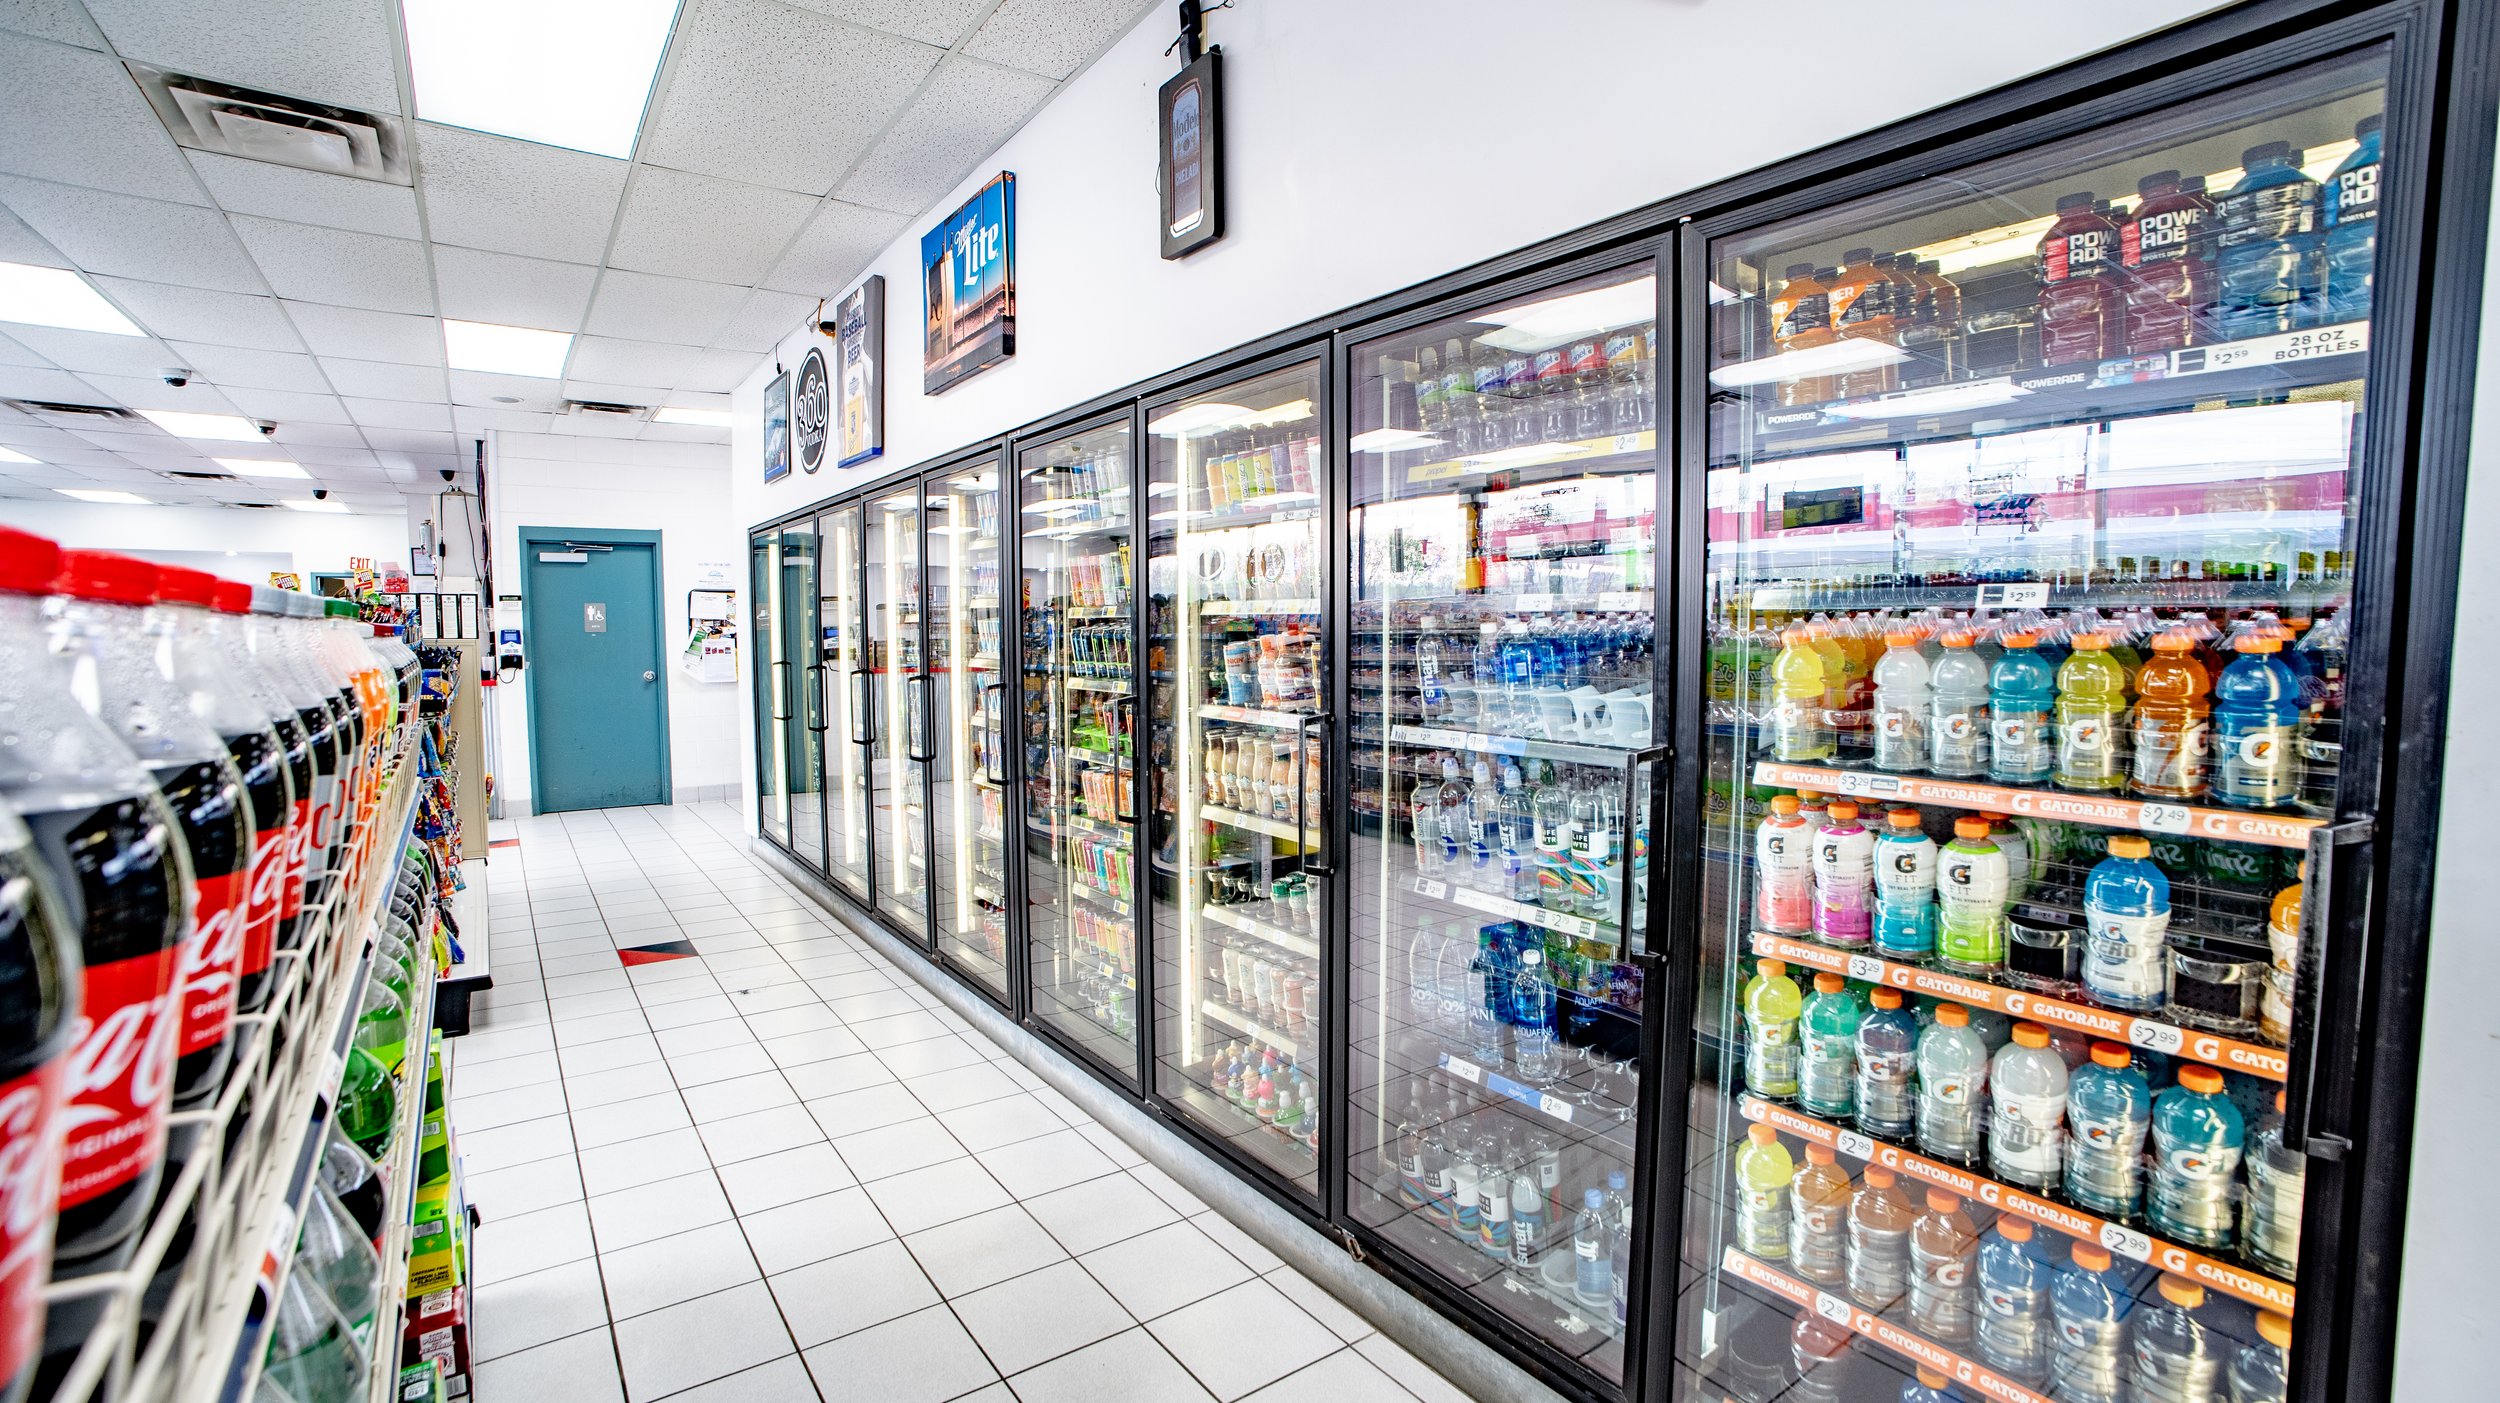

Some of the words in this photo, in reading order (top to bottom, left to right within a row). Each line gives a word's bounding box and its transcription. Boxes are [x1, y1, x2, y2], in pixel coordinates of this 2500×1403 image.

[2339, 164, 2381, 191] PO
[2338, 183, 2380, 209] AD
[2141, 226, 2188, 250] ADE
[963, 222, 999, 286] Lite
[2069, 246, 2108, 265] ADE
[2141, 252, 2167, 263] SPORTS
[2274, 339, 2360, 361] BOTTLES
[2290, 334, 2312, 347] 28
[2318, 329, 2345, 344] OZ
[2021, 372, 2086, 390] POWERADE
[797, 373, 826, 449] 360
[1767, 410, 1817, 426] POWERADE
[806, 428, 823, 449] VODKA
[350, 556, 371, 570] EXIT
[1420, 654, 1435, 698] smart
[1944, 713, 1969, 739] G
[2000, 719, 2025, 746] G
[2069, 718, 2102, 751] G
[2239, 732, 2280, 768] G
[1761, 765, 1777, 783] G
[1782, 770, 1838, 788] GATORAD
[1898, 780, 1913, 799] G
[1920, 785, 1998, 805] GATORADE
[2011, 793, 2032, 813] G
[2039, 799, 2128, 820] GATORADE
[2203, 813, 2228, 836] G
[1572, 840, 1588, 851] WTR
[1573, 831, 1588, 843] LIFE
[1768, 836, 1785, 854] G
[1822, 844, 1838, 863] G
[1895, 852, 1917, 874] G
[1895, 874, 1918, 883] FIT
[1949, 864, 1972, 885] G
[2103, 921, 2123, 940] G
[1760, 937, 1775, 954] G
[1779, 944, 1842, 968] GATORADE
[1891, 967, 1909, 986] G
[1915, 975, 1992, 1002] GATORADE
[2005, 994, 2025, 1013] G
[2032, 1003, 2122, 1033] GATORADE
[1517, 1024, 1554, 1038] AQUAFINA
[2194, 1038, 2218, 1060] G
[1867, 1056, 1890, 1081] G
[1933, 1078, 1963, 1104] G
[1751, 1102, 1766, 1120] G
[1770, 1110, 1832, 1141] GATORADE
[2002, 1100, 2022, 1121] G
[2077, 1119, 2113, 1150] G
[1880, 1149, 1898, 1168] G
[2170, 1149, 2209, 1181] G
[1980, 1182, 1999, 1204] G
[2006, 1195, 2092, 1235] GATORADE
[1805, 1211, 1827, 1233] G
[1515, 1221, 1529, 1265] smart
[410, 1274, 434, 1284] LEMON
[434, 1270, 449, 1279] LIME
[436, 1264, 449, 1272] FREE
[1731, 1255, 1744, 1273] G
[1750, 1266, 1810, 1301] GATORADE
[1936, 1262, 1965, 1287] G
[2162, 1249, 2187, 1272] G
[2195, 1264, 2294, 1308] GATORAD
[1986, 1289, 2014, 1317] G
[1855, 1314, 1872, 1334] G
[1878, 1326, 1949, 1368] GATORADE
[2059, 1317, 2085, 1348] G
[1956, 1361, 1972, 1382] G
